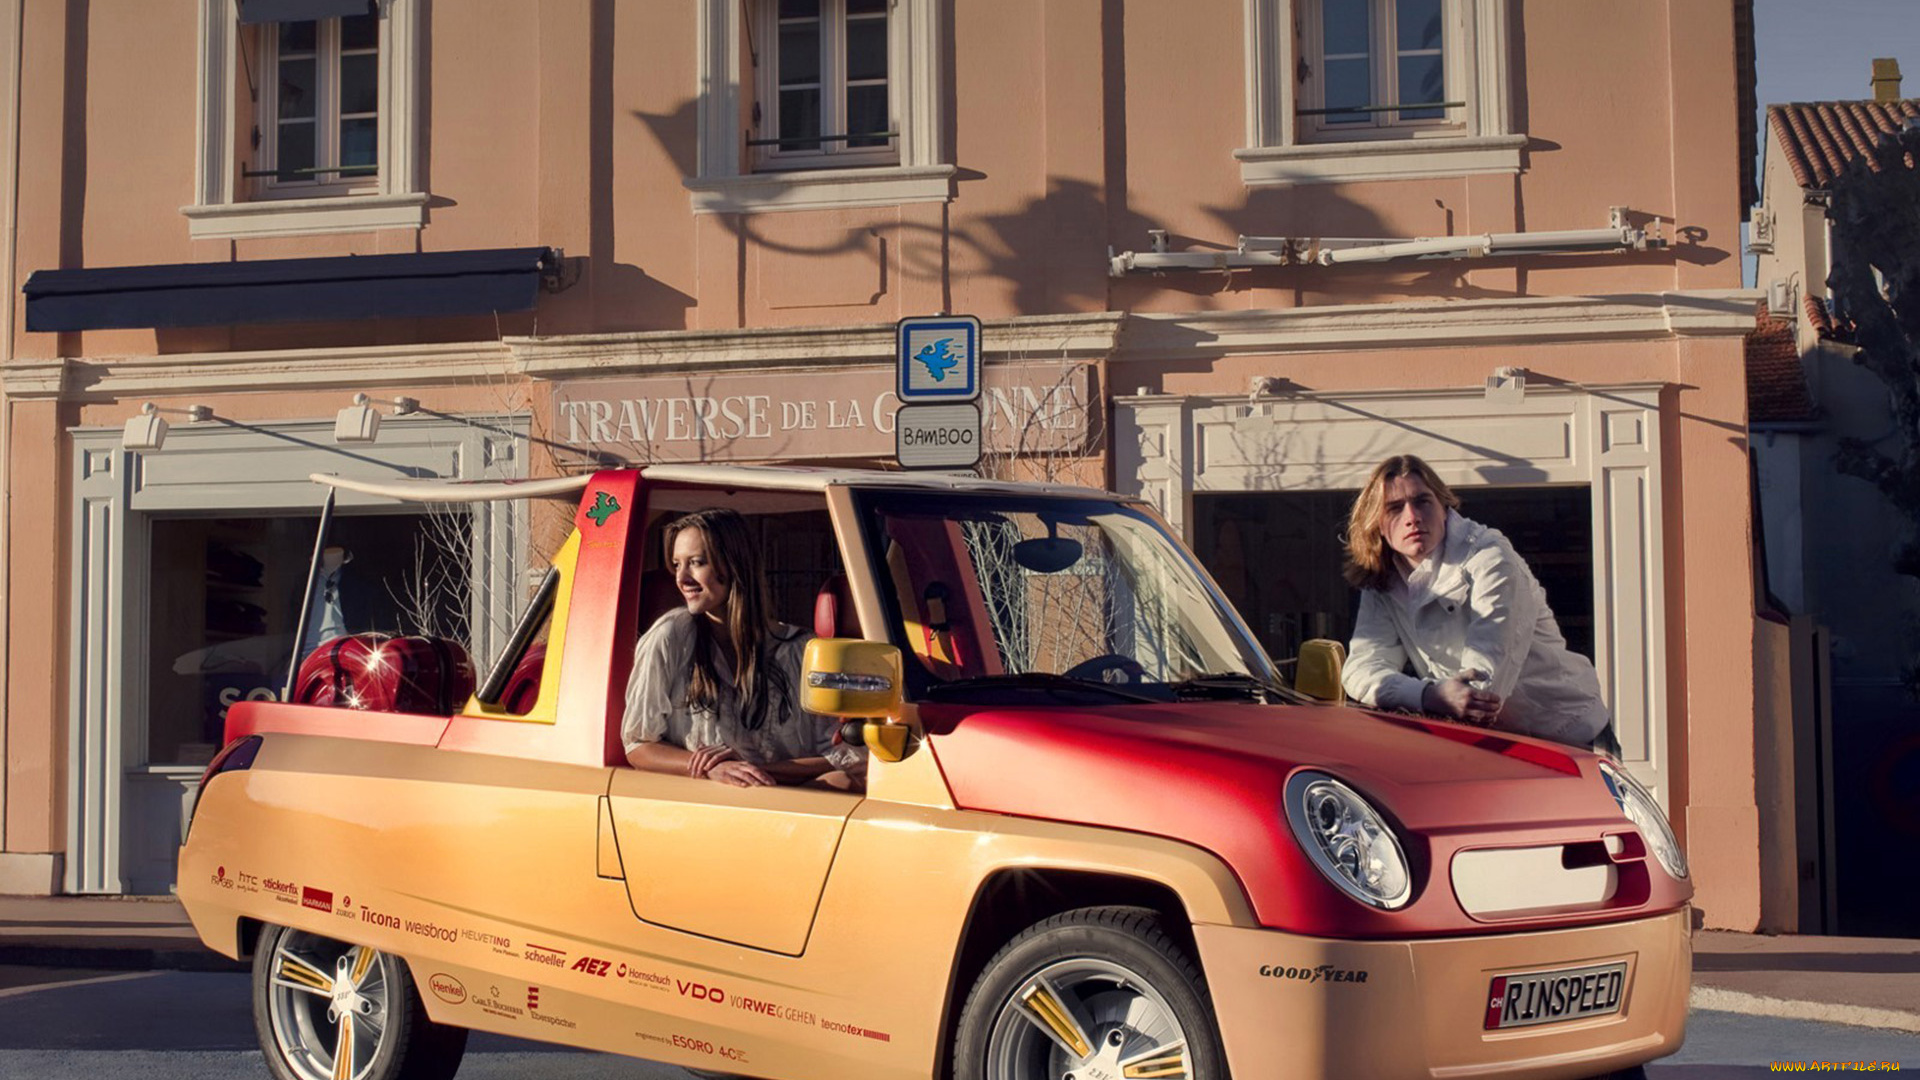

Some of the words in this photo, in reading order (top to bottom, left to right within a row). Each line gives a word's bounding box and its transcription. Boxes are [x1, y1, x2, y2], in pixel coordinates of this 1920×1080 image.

[560, 396, 772, 444] TRAVERSE
[781, 400, 817, 430] DE
[826, 399, 865, 429] LA
[904, 427, 973, 446] BAMBOO
[262, 878, 299, 896] stickerfix
[303, 897, 332, 911] HARMAN
[360, 905, 400, 930] Ticona
[405, 920, 459, 943] weisbrod
[461, 928, 511, 948] HELVETING
[524, 950, 566, 968] schoeller
[570, 956, 612, 978] AEZ
[628, 967, 671, 986] Hornschuch
[1259, 965, 1368, 983] GOODYEAR
[432, 980, 464, 997] Henkel
[676, 979, 725, 1004] VDO
[1490, 997, 1503, 1008] CH
[1504, 970, 1622, 1021] RINSPEED
[730, 995, 783, 1018] VORWEG
[785, 1007, 816, 1026] GEHEN
[821, 1018, 864, 1037] tecnotex
[672, 1034, 714, 1055] ESORO
